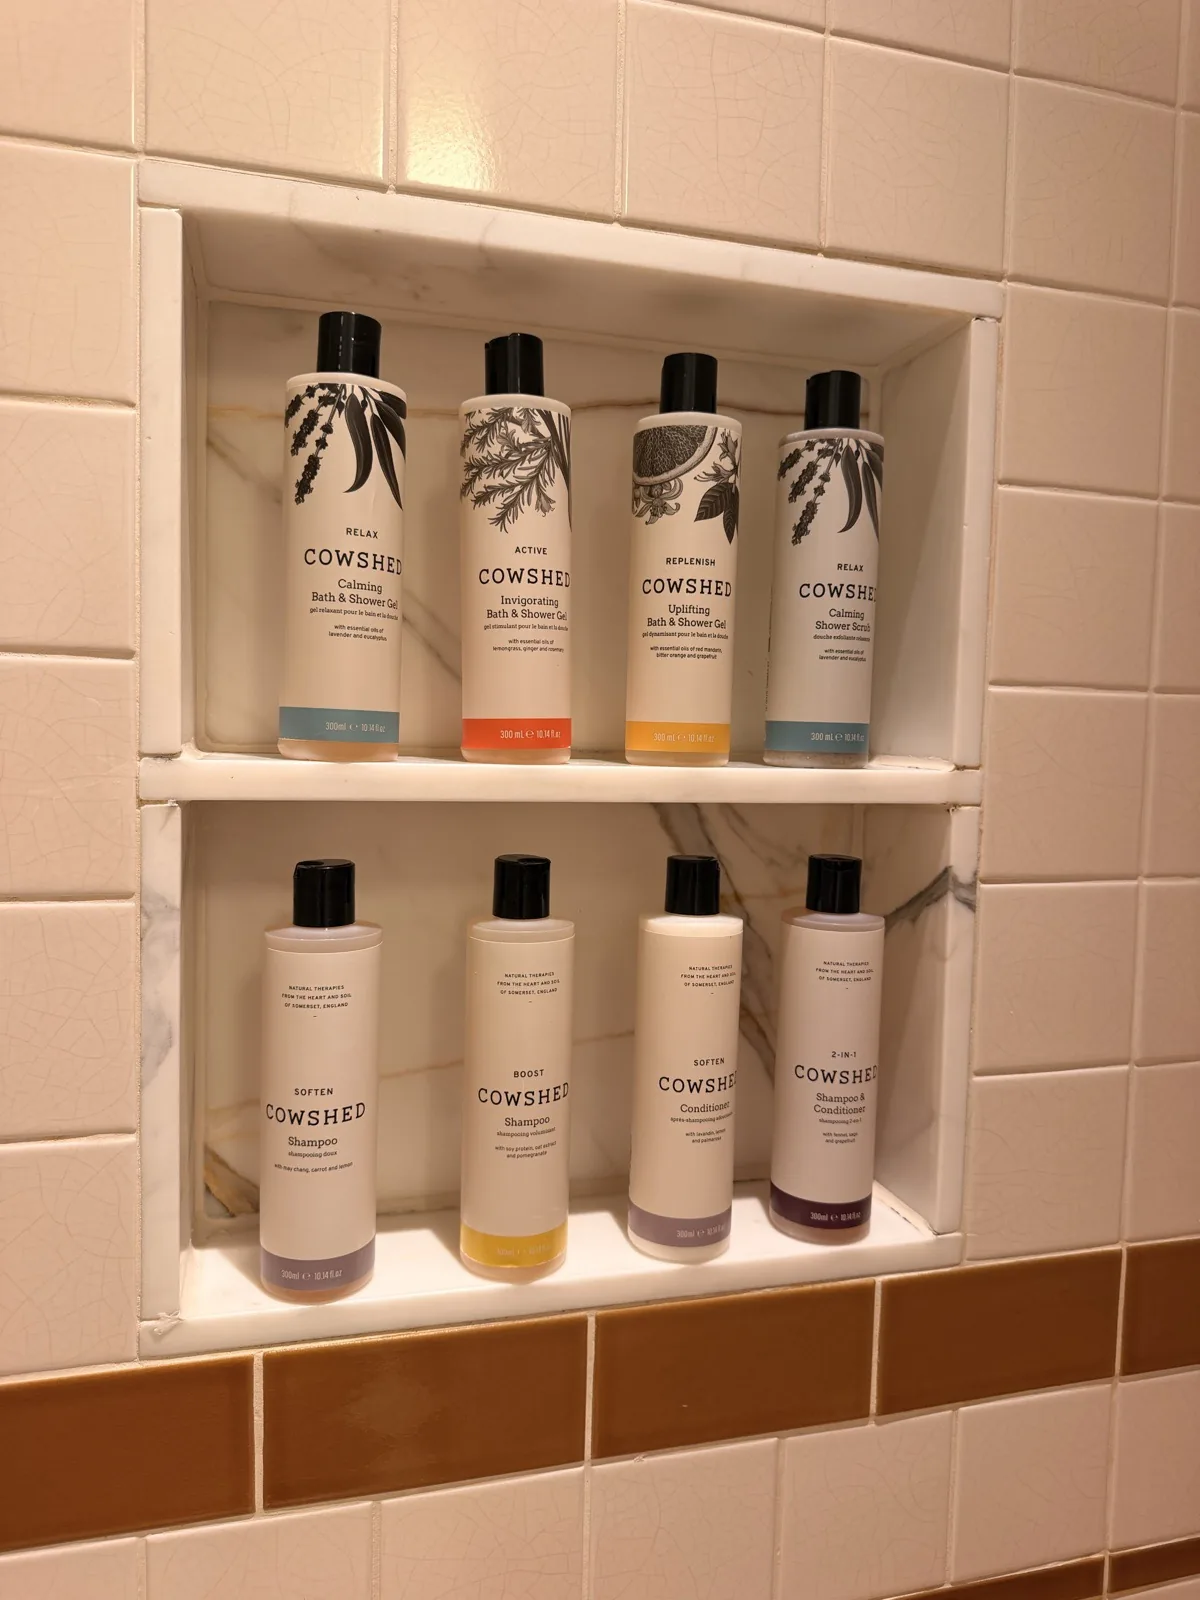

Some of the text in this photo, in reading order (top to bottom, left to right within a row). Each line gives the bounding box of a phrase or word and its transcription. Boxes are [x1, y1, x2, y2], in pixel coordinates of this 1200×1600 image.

[346, 527, 378, 539] RELAX
[515, 546, 548, 555] ACTIVE
[304, 548, 402, 575] COWSHED
[666, 558, 716, 566] REPLENISH
[837, 563, 863, 572] RELAX
[479, 568, 570, 587] COWSHED
[338, 578, 383, 594] Calming
[642, 578, 731, 597] COWSHED
[312, 592, 398, 610] Bath & Shower Gel
[501, 596, 559, 608] Invigorating
[487, 609, 567, 621] Bath & Shower Gel
[668, 604, 710, 616] Uplifting
[829, 608, 864, 621] Calming
[647, 617, 726, 629] Bath & Shower Gel
[815, 621, 870, 632] Shower Scrub
[500, 730, 550, 739] 300 mL 10.14
[653, 733, 665, 741] 300
[811, 732, 823, 741] 300
[694, 1058, 725, 1066] SOFTEN
[513, 1069, 544, 1078] BOOST
[294, 1088, 333, 1096] SOFTEN
[478, 1082, 569, 1106] COWSHED
[816, 1093, 858, 1104] Shampoo
[680, 1101, 730, 1113] Conditioner
[814, 1104, 865, 1114] Conditioner
[266, 1102, 365, 1126] COWSHED
[504, 1116, 550, 1127] Shampoo
[288, 1136, 338, 1148] Shampoo
